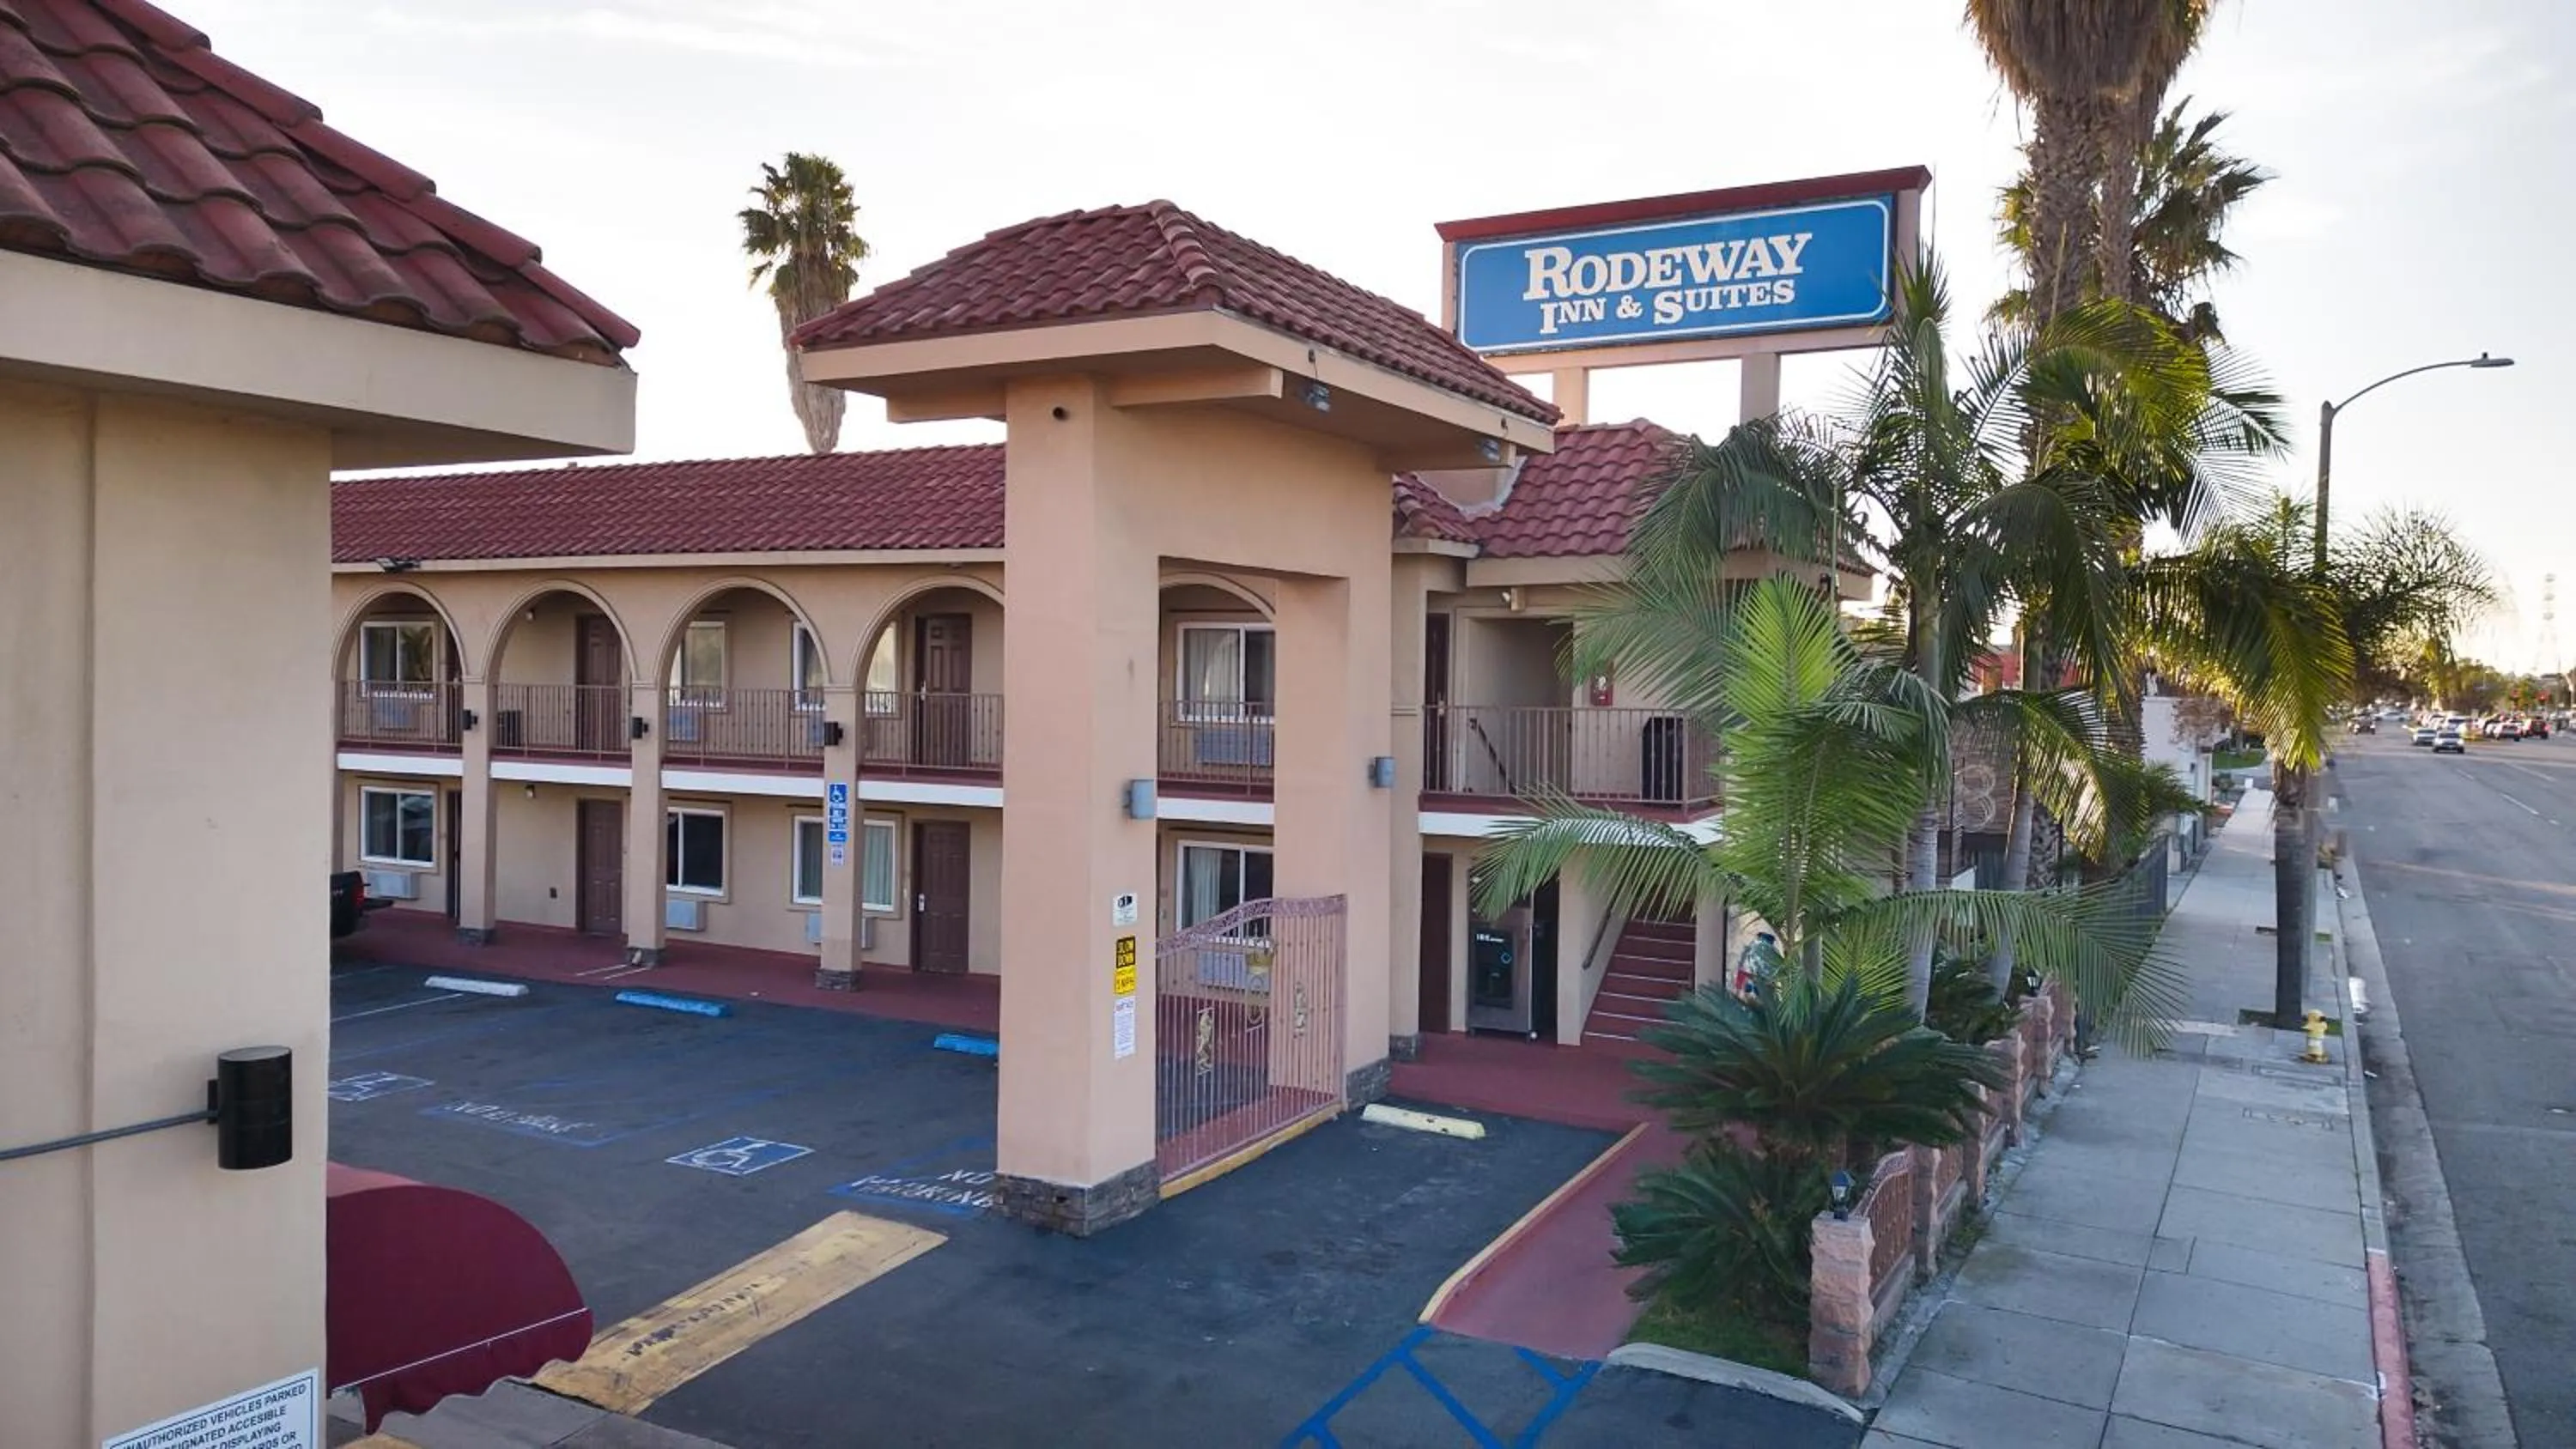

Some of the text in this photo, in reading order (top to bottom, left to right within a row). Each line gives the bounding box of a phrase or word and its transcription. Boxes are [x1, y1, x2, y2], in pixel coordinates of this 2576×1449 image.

[1522, 233, 1813, 300] RODEWAY
[1540, 279, 1795, 334] INN & SUITES
[210, 1399, 262, 1425] VEHICLES
[264, 1383, 307, 1405] PARKED
[228, 1405, 287, 1434] ACCESIBLE
[282, 1431, 297, 1445] OR
